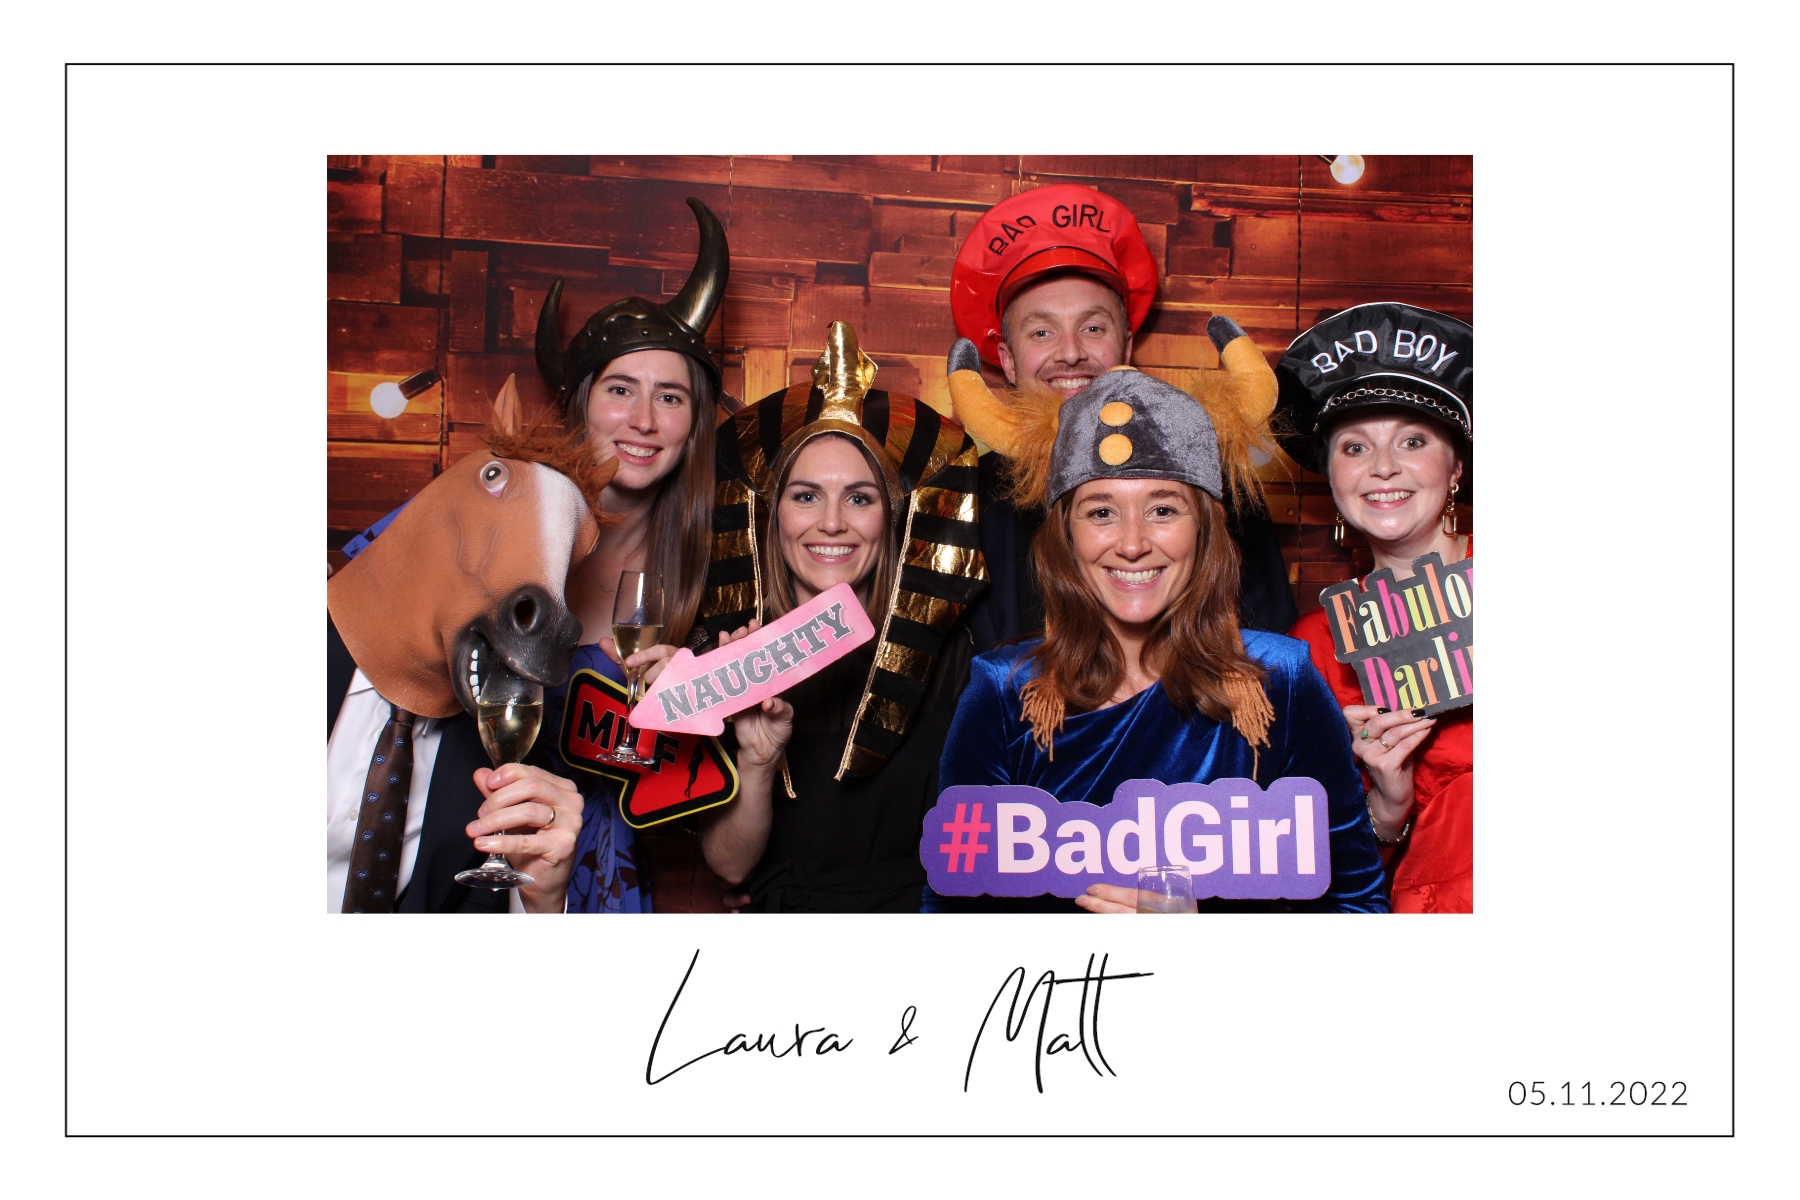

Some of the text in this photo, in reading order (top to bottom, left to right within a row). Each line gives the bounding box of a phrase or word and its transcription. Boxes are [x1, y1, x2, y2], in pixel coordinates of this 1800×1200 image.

[988, 204, 1110, 256] BAD GIRL
[1310, 329, 1459, 374] BAD BOY
[656, 601, 852, 724] NAUGHTY
[1360, 632, 1473, 712] Darli
[939, 795, 1316, 875] #BadGirl
